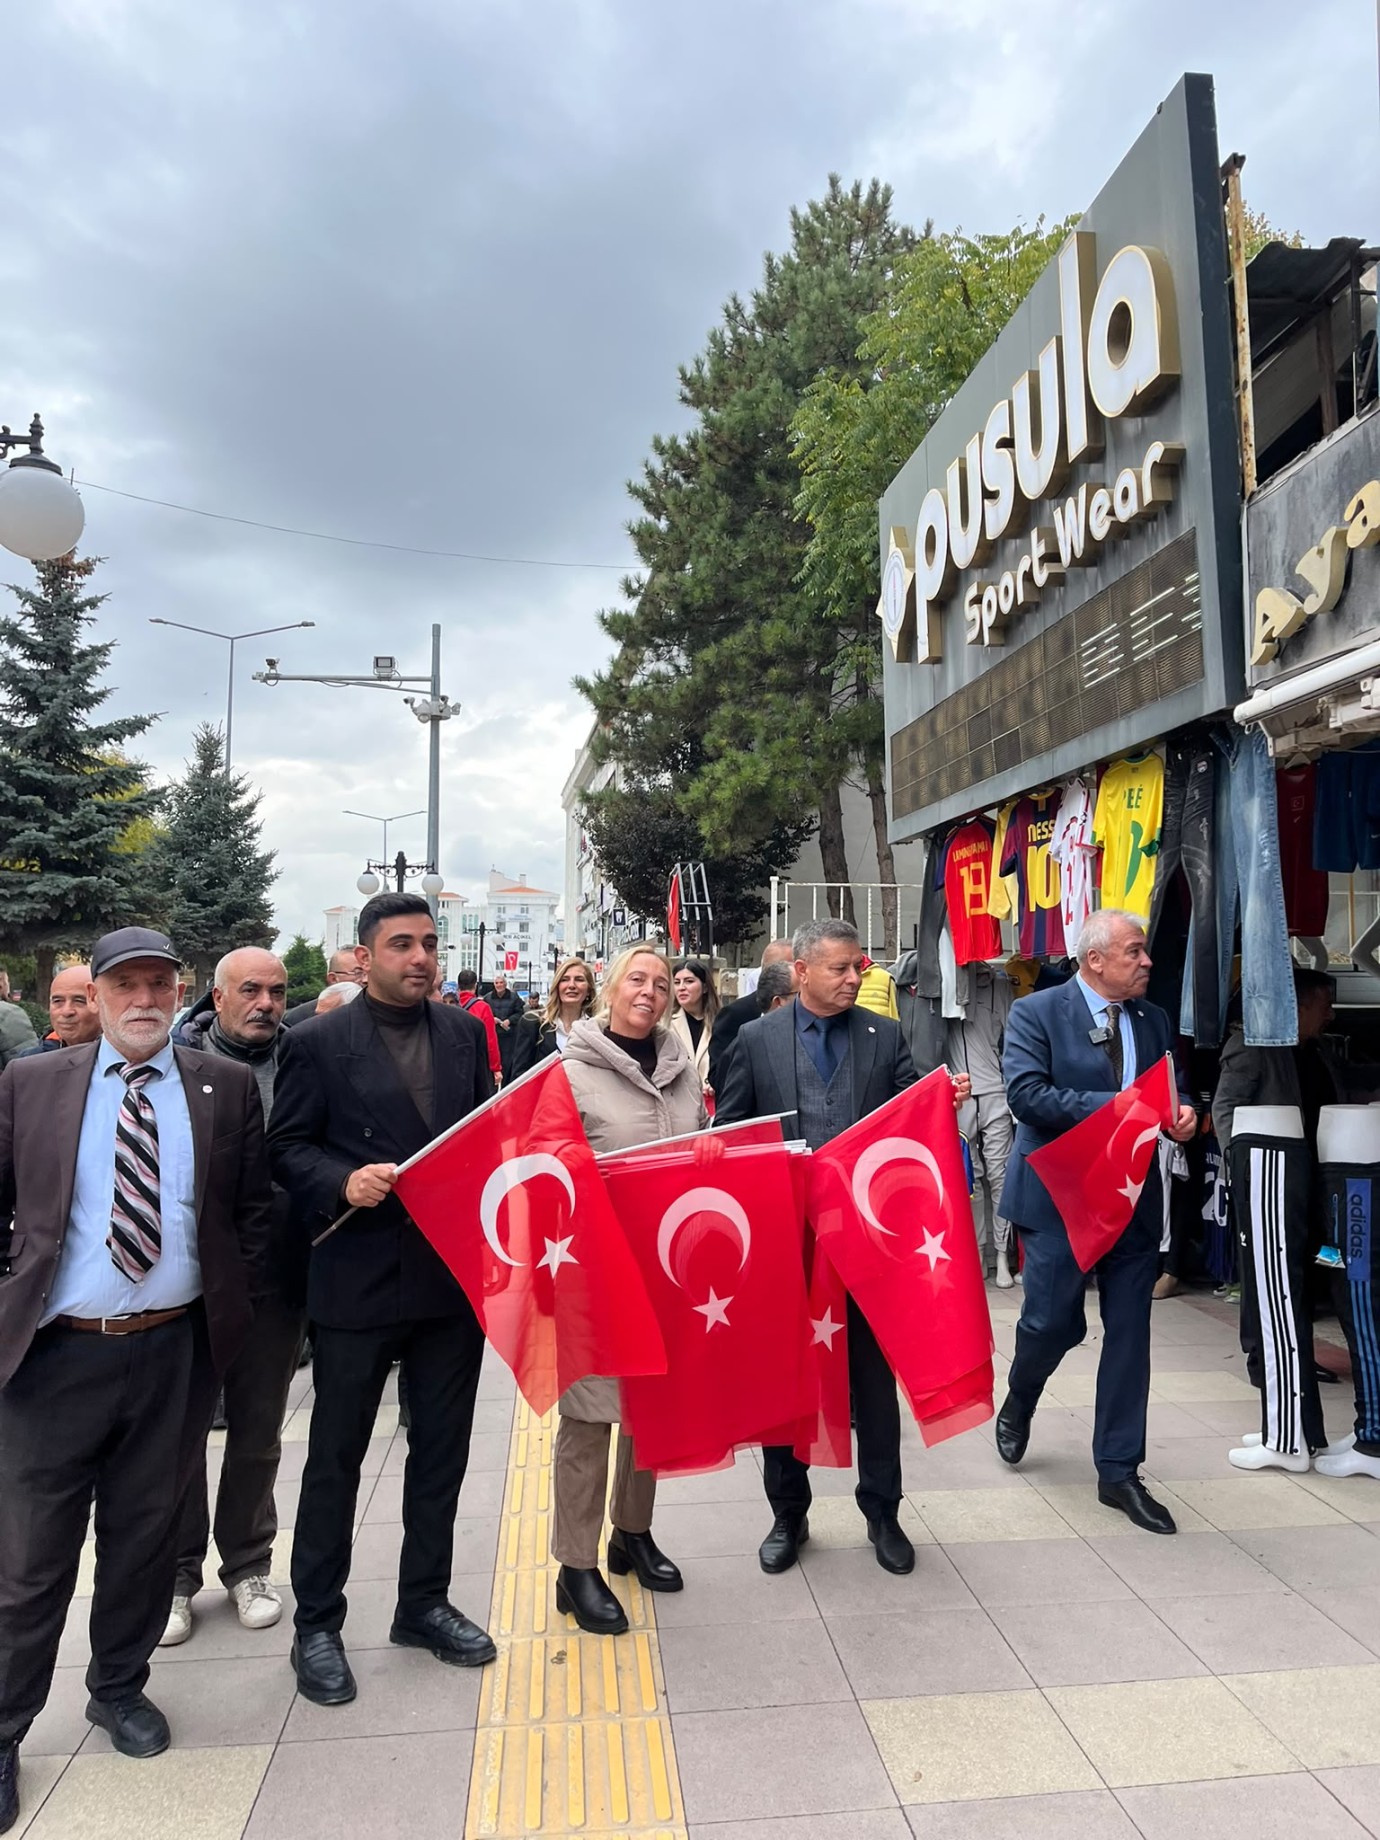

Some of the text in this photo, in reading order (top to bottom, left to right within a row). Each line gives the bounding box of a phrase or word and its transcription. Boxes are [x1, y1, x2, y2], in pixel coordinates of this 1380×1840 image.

[915, 232, 1170, 664] pusula
[964, 441, 1172, 648] Sport Wear
[1027, 842, 1062, 912] 10
[1350, 1193, 1367, 1259] adidas
